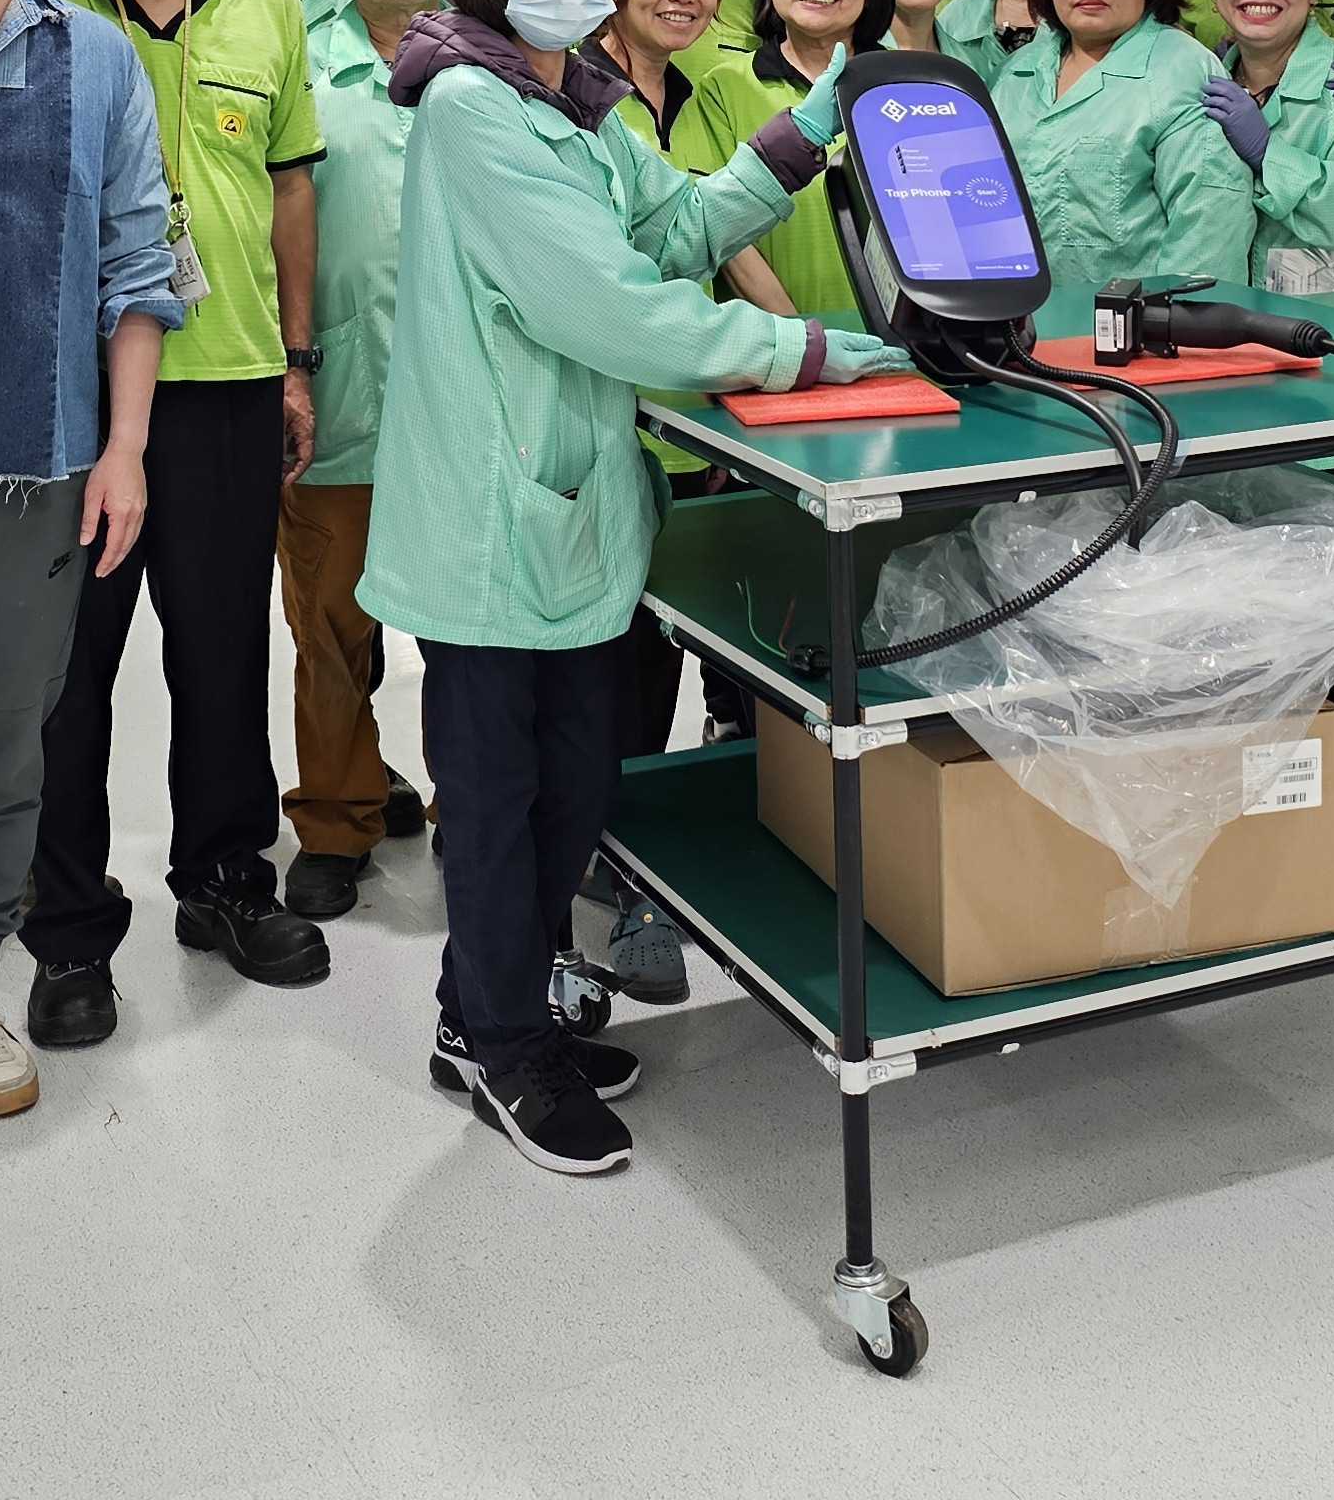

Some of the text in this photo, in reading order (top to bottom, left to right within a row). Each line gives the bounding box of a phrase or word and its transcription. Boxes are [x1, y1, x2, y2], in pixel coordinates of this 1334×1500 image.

[909, 102, 957, 117] xeal
[884, 187, 951, 200] Tap Phone
